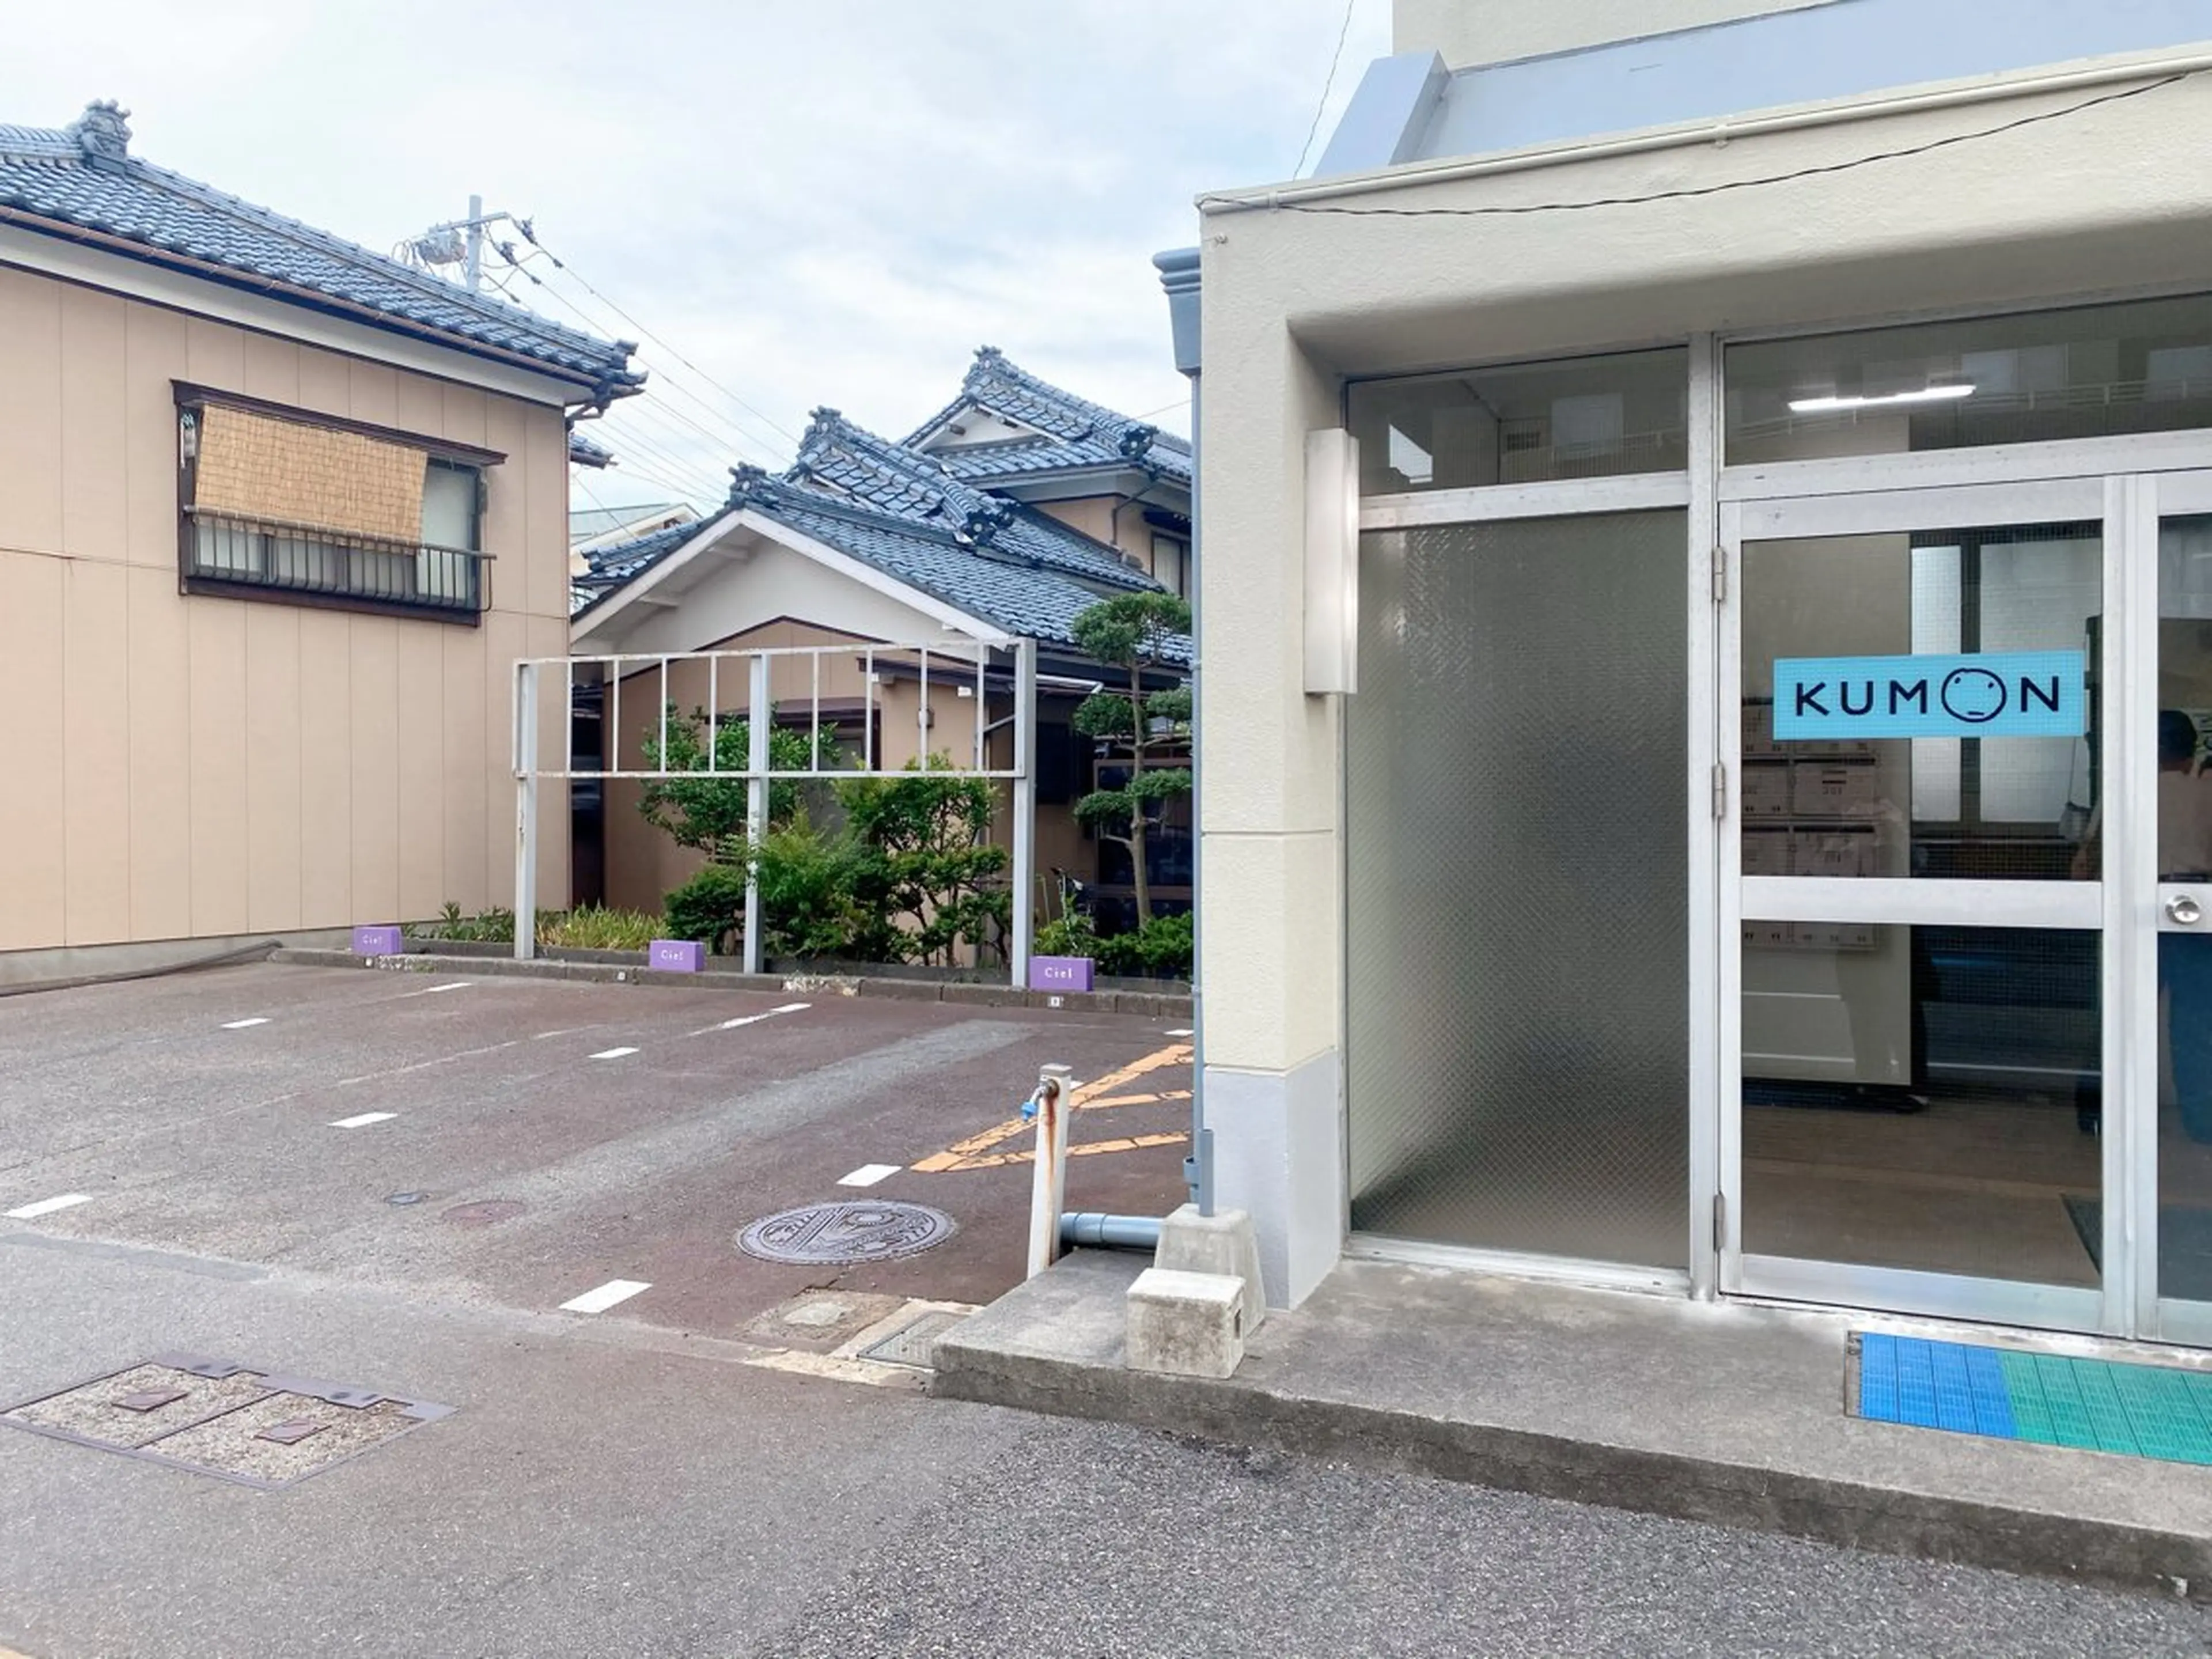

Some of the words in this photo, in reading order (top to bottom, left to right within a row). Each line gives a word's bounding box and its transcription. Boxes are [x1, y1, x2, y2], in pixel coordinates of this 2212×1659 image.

[1796, 667, 2059, 723] KUMON
[661, 949, 684, 961] Ciel
[1044, 967, 1073, 979] Ciel
